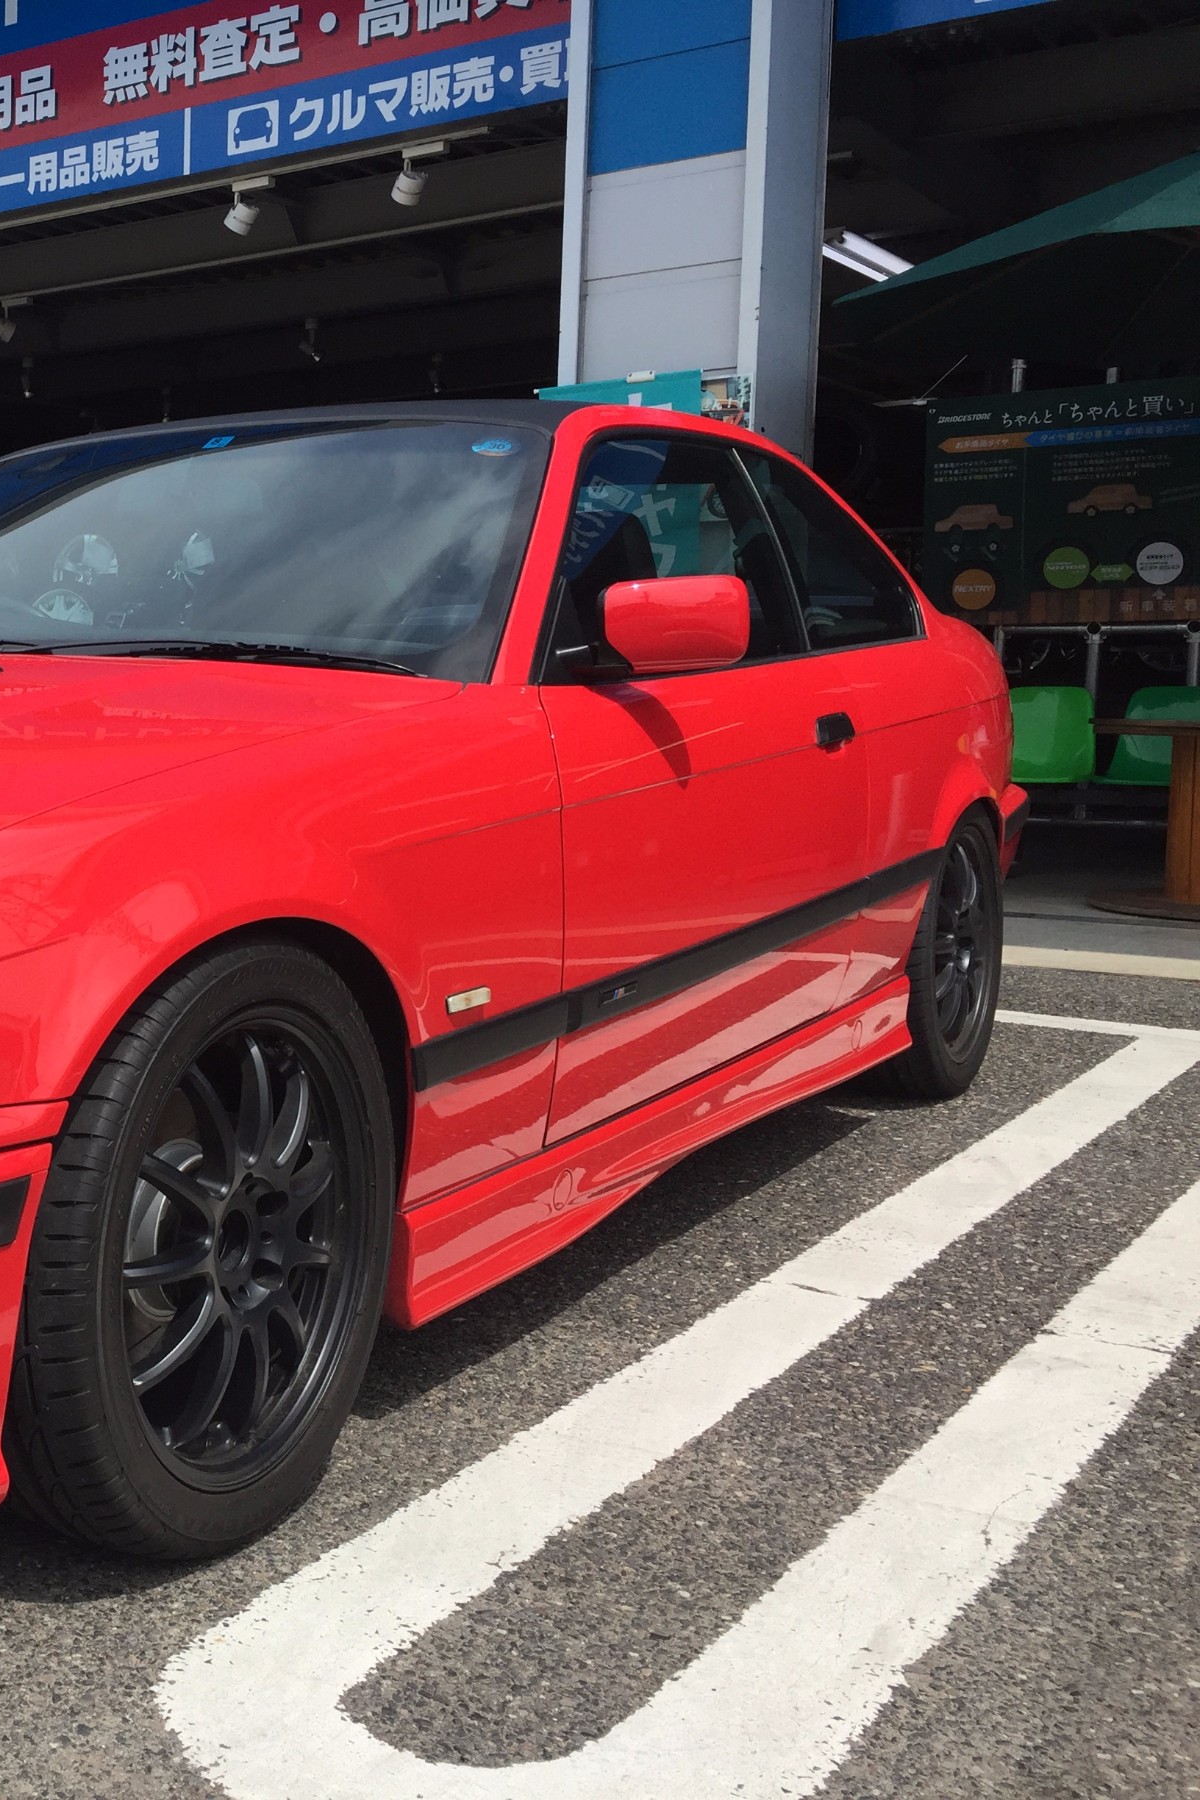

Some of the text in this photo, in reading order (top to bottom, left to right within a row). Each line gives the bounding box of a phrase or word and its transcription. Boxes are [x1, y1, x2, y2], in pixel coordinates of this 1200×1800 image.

[289, 37, 569, 142] クルマ販売・買
[937, 412, 992, 424] BRIDGESTONE
